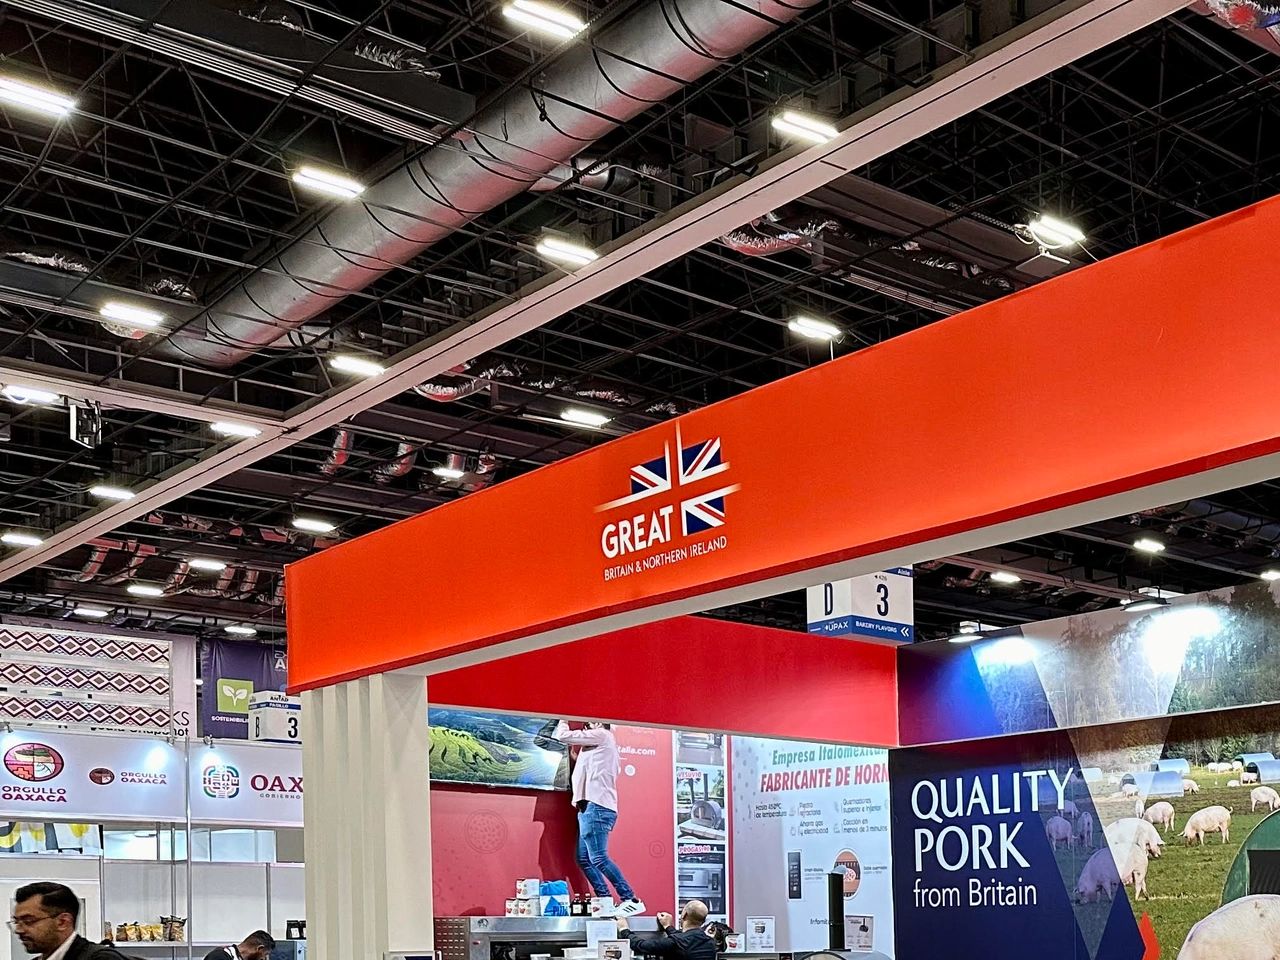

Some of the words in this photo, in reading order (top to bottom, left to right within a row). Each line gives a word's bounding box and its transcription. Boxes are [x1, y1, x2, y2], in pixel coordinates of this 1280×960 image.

[601, 504, 674, 559] GREAT
[604, 560, 634, 581] BRITAIN
[635, 560, 642, 573] &
[642, 547, 688, 570] NORTHERN
[689, 535, 727, 557] IRELAND
[824, 582, 834, 616] D
[876, 583, 889, 617] 3
[287, 717, 298, 739] 3
[772, 749, 816, 768] Empresa
[2, 785, 67, 795] ORGULLO
[121, 771, 167, 779] ORGULLO
[121, 777, 167, 785] OAXACA
[760, 767, 832, 793] FABRICANTE
[835, 765, 851, 787] DE
[1, 792, 67, 803] OAXACA
[911, 767, 1074, 824] QUALITY
[914, 821, 1031, 872] PORK
[913, 878, 960, 908] from
[968, 876, 1037, 907] Britain
